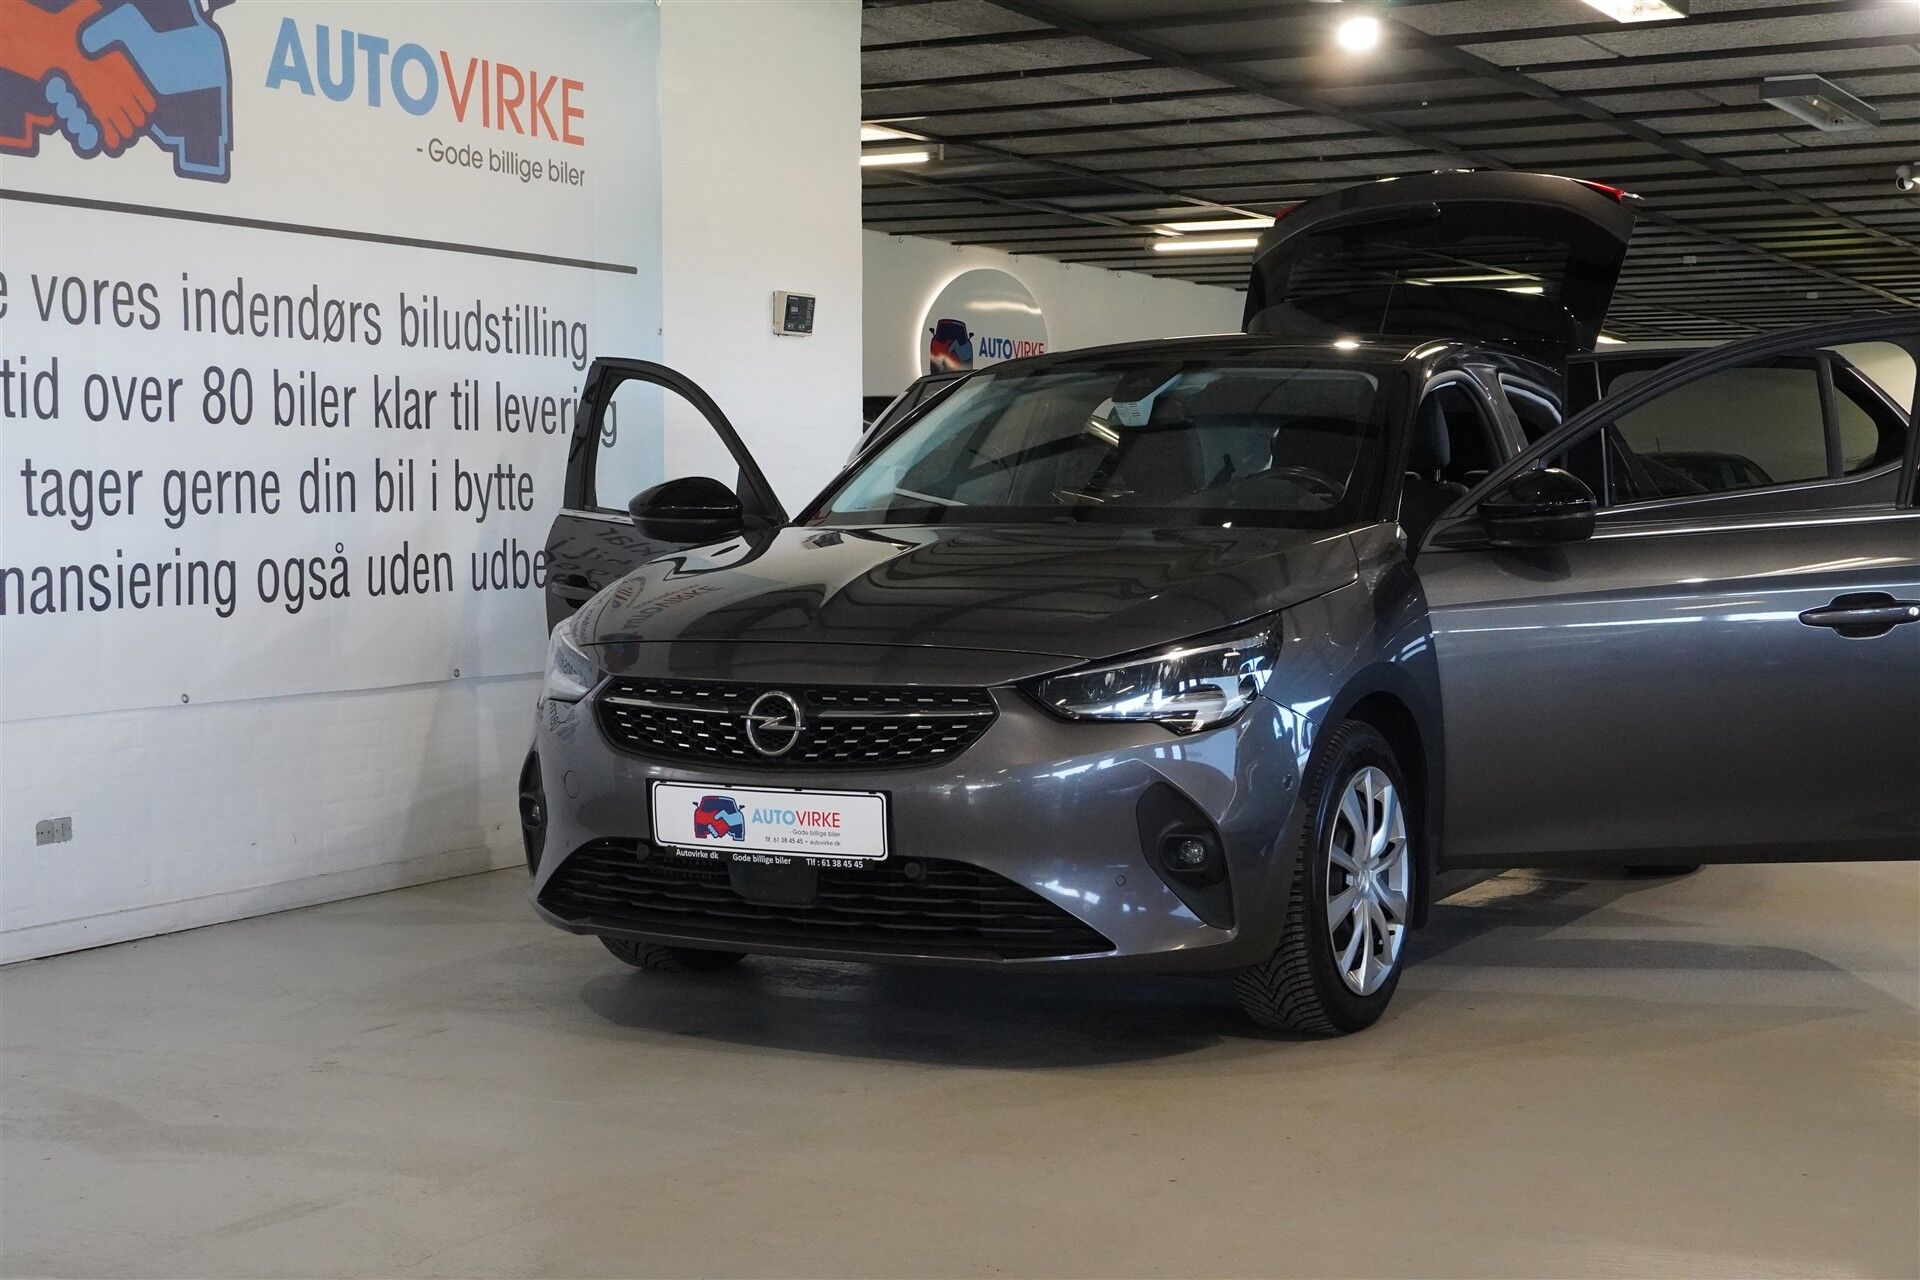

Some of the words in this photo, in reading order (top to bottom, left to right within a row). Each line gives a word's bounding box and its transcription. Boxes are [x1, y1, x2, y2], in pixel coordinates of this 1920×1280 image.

[266, 17, 585, 147] AUTOVIRKE
[428, 137, 483, 169] Gode
[489, 148, 543, 183] billige
[548, 158, 585, 186] biler
[31, 273, 160, 331] vores
[182, 272, 382, 346] indendørs
[400, 291, 588, 372] biludstilling
[979, 337, 1045, 359] AUTOVIRKE
[84, 373, 184, 426] over
[202, 365, 254, 427] 80
[273, 368, 357, 431] biler
[373, 374, 437, 431] klar
[450, 379, 479, 432] til
[495, 381, 617, 449] leverig
[20, 458, 144, 532] tager
[163, 469, 281, 530] gerne
[300, 456, 356, 514] din
[375, 457, 414, 513] bil
[431, 458, 438, 513] i
[454, 458, 534, 524] bytte
[257, 541, 351, 615] også
[367, 541, 454, 597] uden
[752, 808, 840, 828] AUTOVIRKE
[792, 828, 809, 836] Gode
[809, 830, 827, 838] billige
[676, 848, 708, 859] Autovirke
[709, 851, 719, 860] dk
[732, 853, 751, 862] Gode
[752, 854, 774, 865] billige
[774, 856, 792, 865] biler
[821, 859, 831, 867] 61
[832, 859, 841, 868] 38
[843, 860, 852, 868] 45
[853, 860, 864, 869] 45
